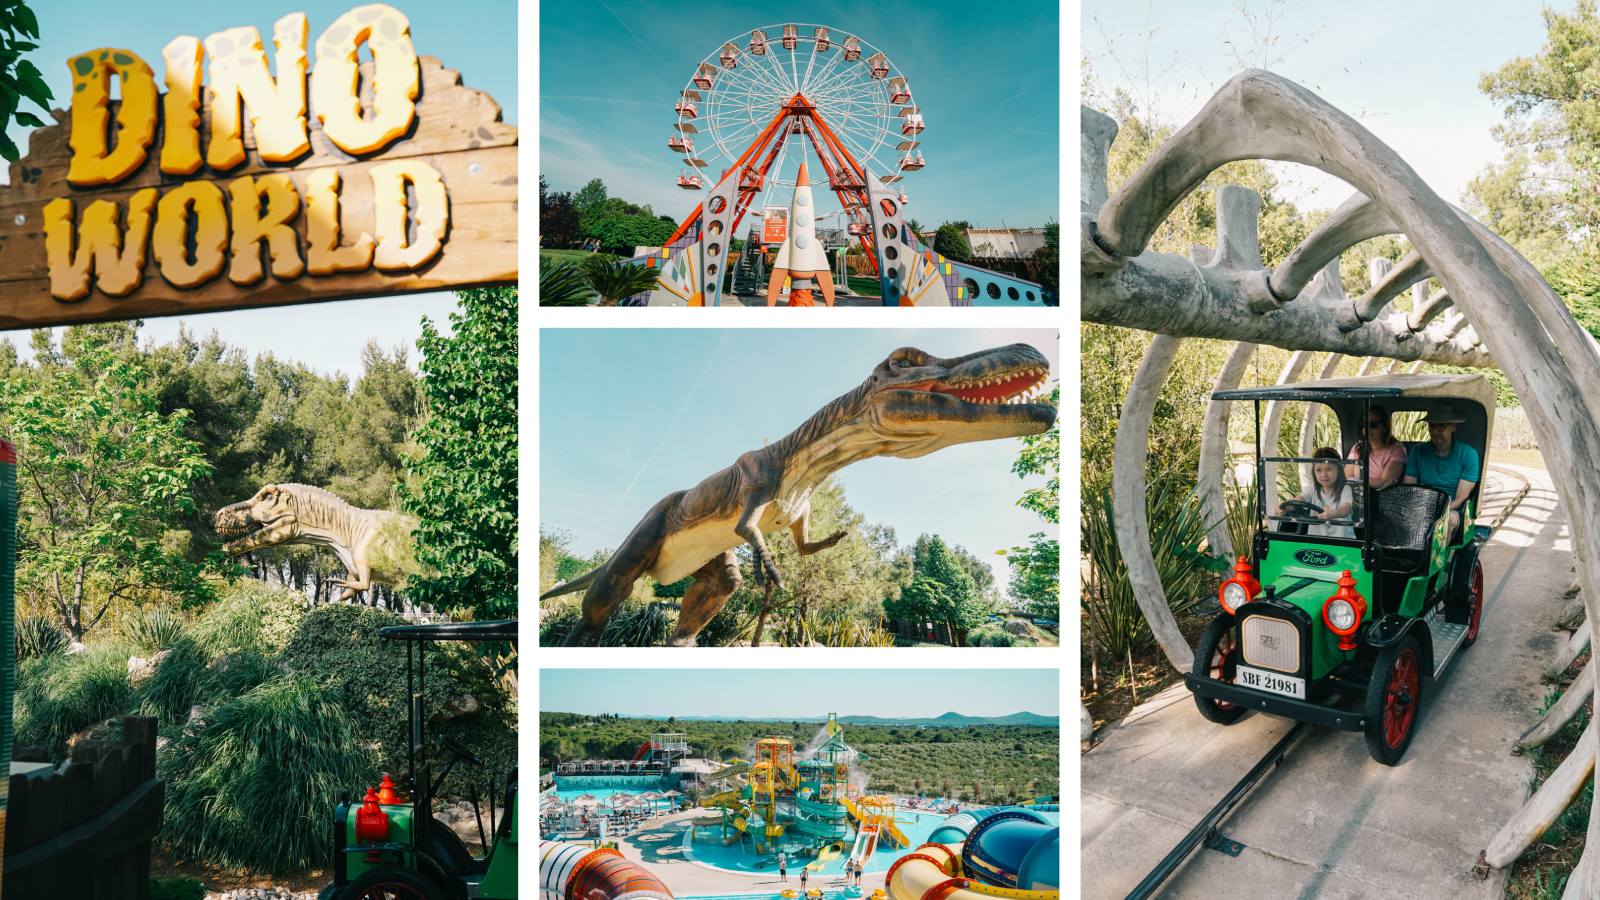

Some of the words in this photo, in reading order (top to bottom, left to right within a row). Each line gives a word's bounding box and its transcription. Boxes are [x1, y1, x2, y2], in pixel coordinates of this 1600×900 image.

[67, 3, 420, 187] DINO
[43, 160, 451, 302] WORLD
[1302, 551, 1328, 565] Ford
[1242, 671, 1261, 686] SBF
[1264, 676, 1297, 694] 21981
